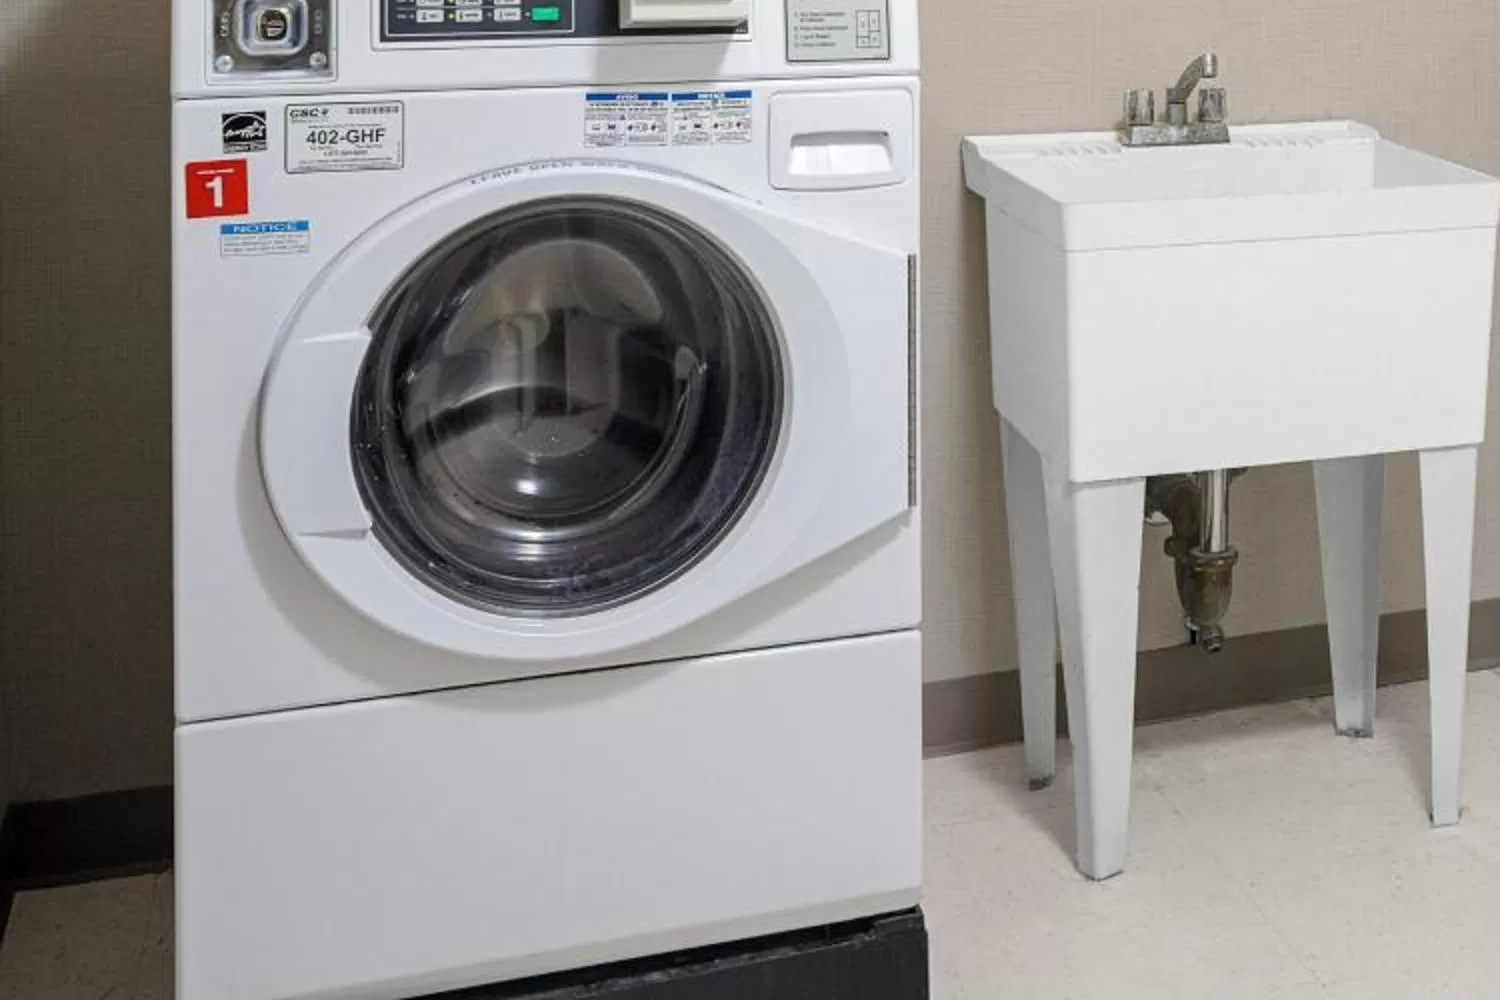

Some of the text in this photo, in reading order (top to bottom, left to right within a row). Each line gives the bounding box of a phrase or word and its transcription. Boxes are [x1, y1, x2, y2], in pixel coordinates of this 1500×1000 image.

[305, 127, 387, 145] 402-GHF
[205, 177, 224, 209] 1
[232, 222, 298, 233] NOTICE
